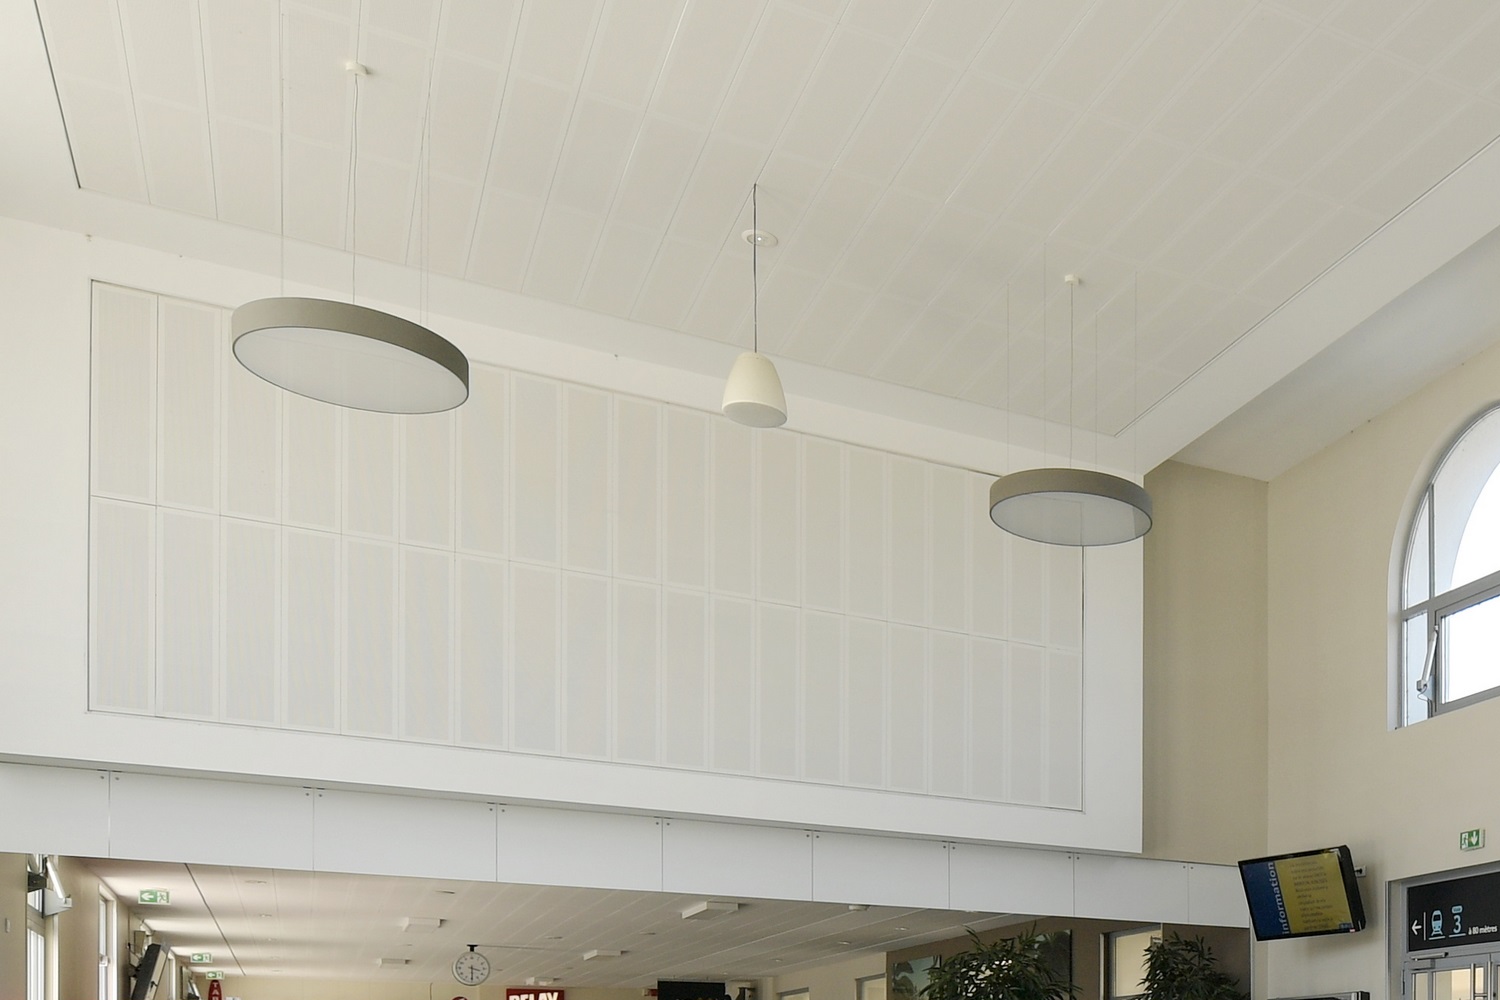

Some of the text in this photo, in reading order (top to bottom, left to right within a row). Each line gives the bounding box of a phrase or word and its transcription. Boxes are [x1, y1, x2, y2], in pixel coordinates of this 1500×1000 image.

[1266, 861, 1291, 935] information
[1453, 914, 1462, 934] 3
[1472, 926, 1479, 935] 80
